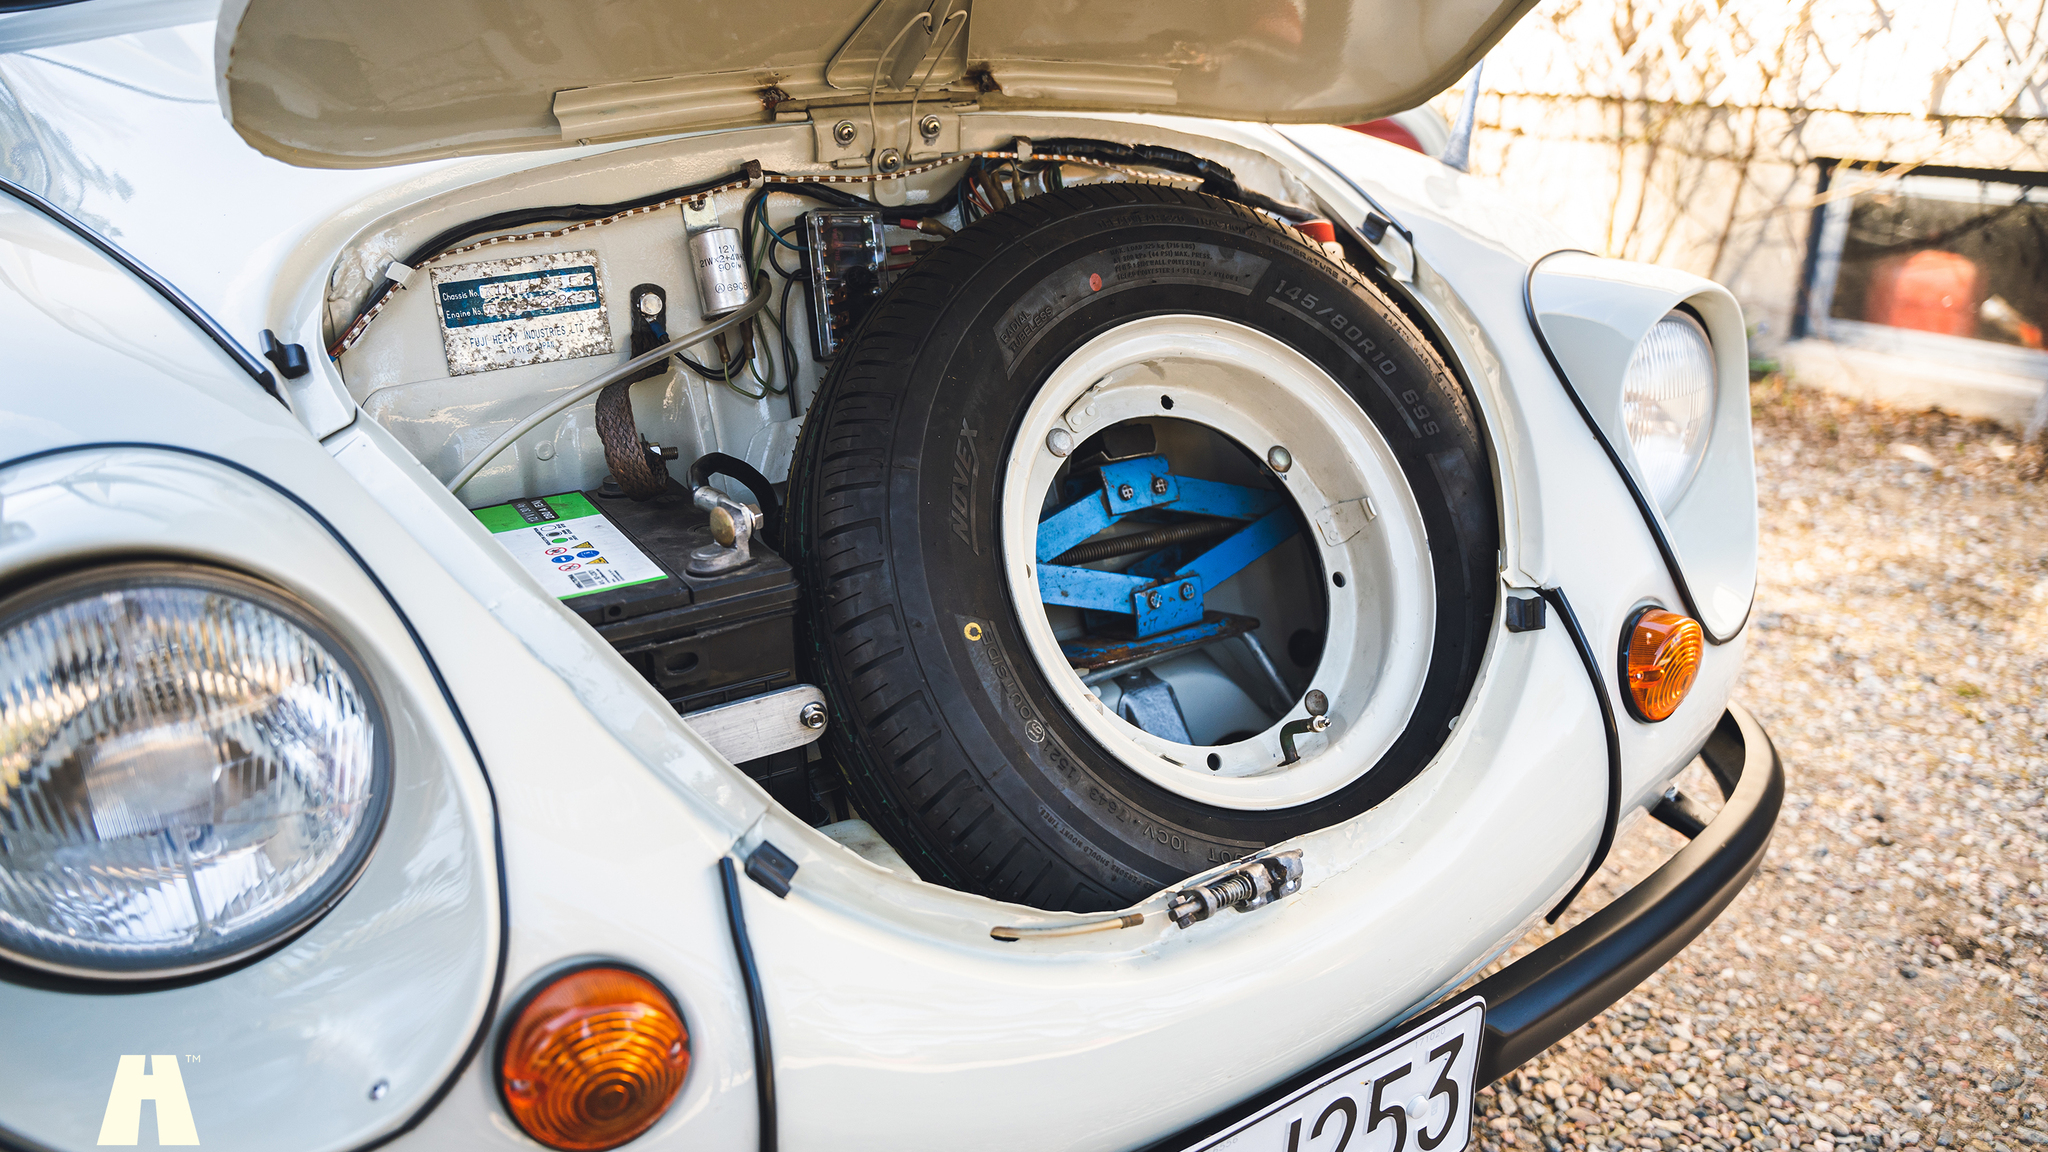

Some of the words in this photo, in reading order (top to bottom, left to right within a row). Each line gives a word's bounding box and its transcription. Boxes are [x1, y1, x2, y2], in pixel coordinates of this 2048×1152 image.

[719, 245, 735, 253] 12V
[1191, 251, 1213, 260] PRESS.
[1195, 217, 1246, 235] TRACTION
[1267, 235, 1339, 279] TEMPERATURE
[442, 290, 468, 301] Chassis
[469, 289, 480, 298] No.
[446, 309, 471, 319] Engine
[472, 307, 484, 316] No.
[469, 336, 488, 347] FUJI
[492, 332, 518, 344] HEAVY
[524, 325, 566, 340] INDUSTRIES
[1000, 311, 1031, 344] RADIAL
[1008, 306, 1053, 353] TUBELESS
[508, 344, 530, 354] TOKYO
[1274, 279, 1397, 376] 145/80R10
[1402, 388, 1440, 436] 69S
[951, 417, 979, 546] NOVEX
[981, 631, 1032, 720] OUTSIDE
[1042, 739, 1078, 779] 1521
[1040, 806, 1060, 828] TIRES.
[1059, 827, 1084, 848] MOUNT
[1143, 822, 1188, 852] 10CV
[1083, 845, 1110, 867] SHOULD
[1111, 865, 1141, 886] PERSONS
[1415, 1026, 1446, 1048] 171020
